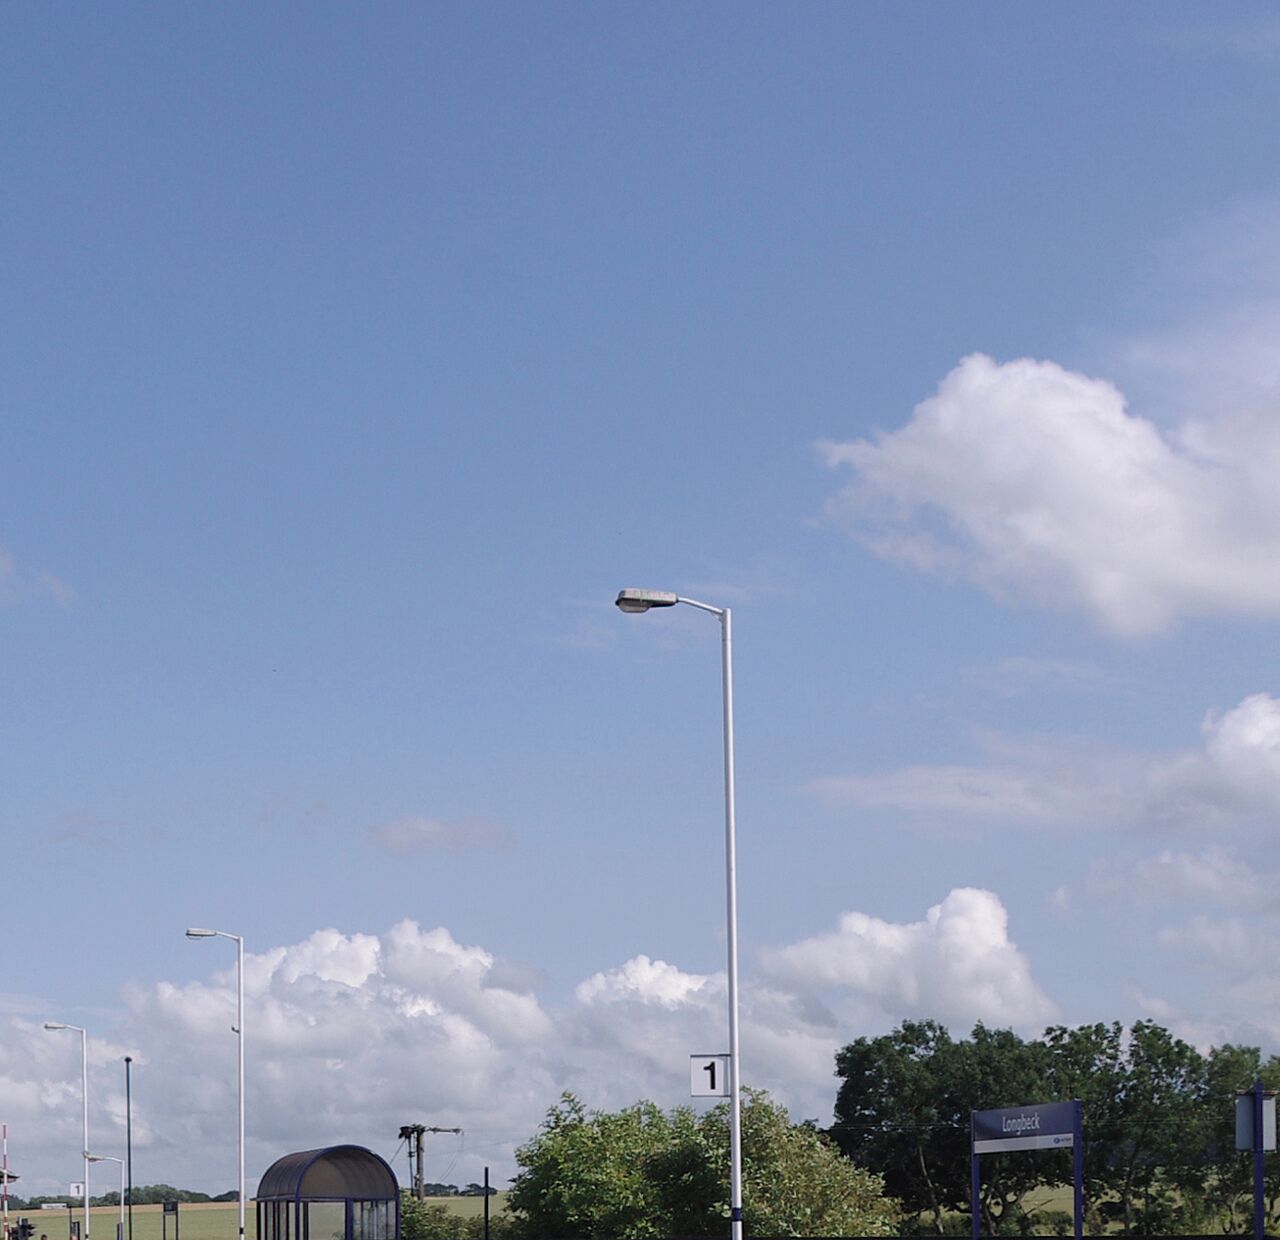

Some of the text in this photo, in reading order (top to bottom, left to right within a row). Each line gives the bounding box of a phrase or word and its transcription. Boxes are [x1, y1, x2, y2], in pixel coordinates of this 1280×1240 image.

[703, 1061, 716, 1090] 1
[1002, 1112, 1040, 1136] Longbeck
[74, 1185, 80, 1195] 1
